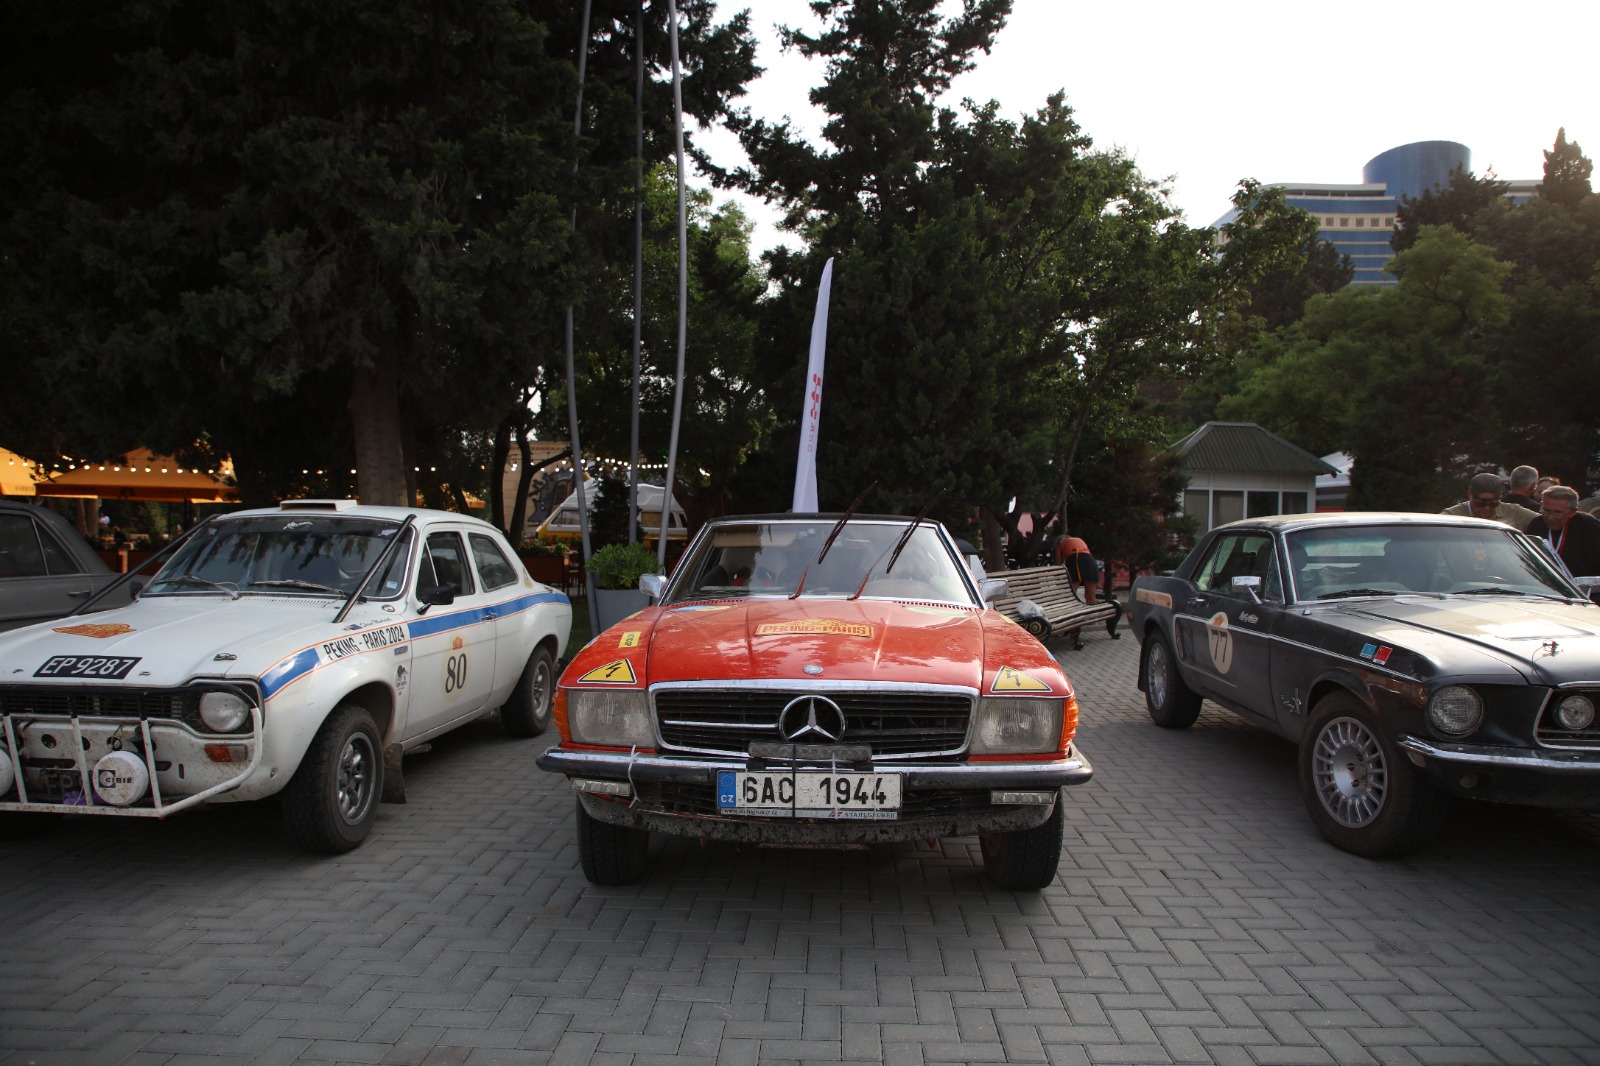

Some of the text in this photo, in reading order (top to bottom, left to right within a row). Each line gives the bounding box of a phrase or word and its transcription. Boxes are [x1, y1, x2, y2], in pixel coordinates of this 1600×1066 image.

[323, 637, 361, 660] PEKING
[362, 629, 387, 650] PARIS
[386, 625, 405, 644] 2024
[823, 625, 867, 635] PARIS
[1211, 628, 1228, 663] 77
[40, 657, 136, 675] EP 9287
[445, 653, 467, 693] 80
[720, 794, 734, 803] CZ
[742, 776, 887, 805] 6AC 1944
